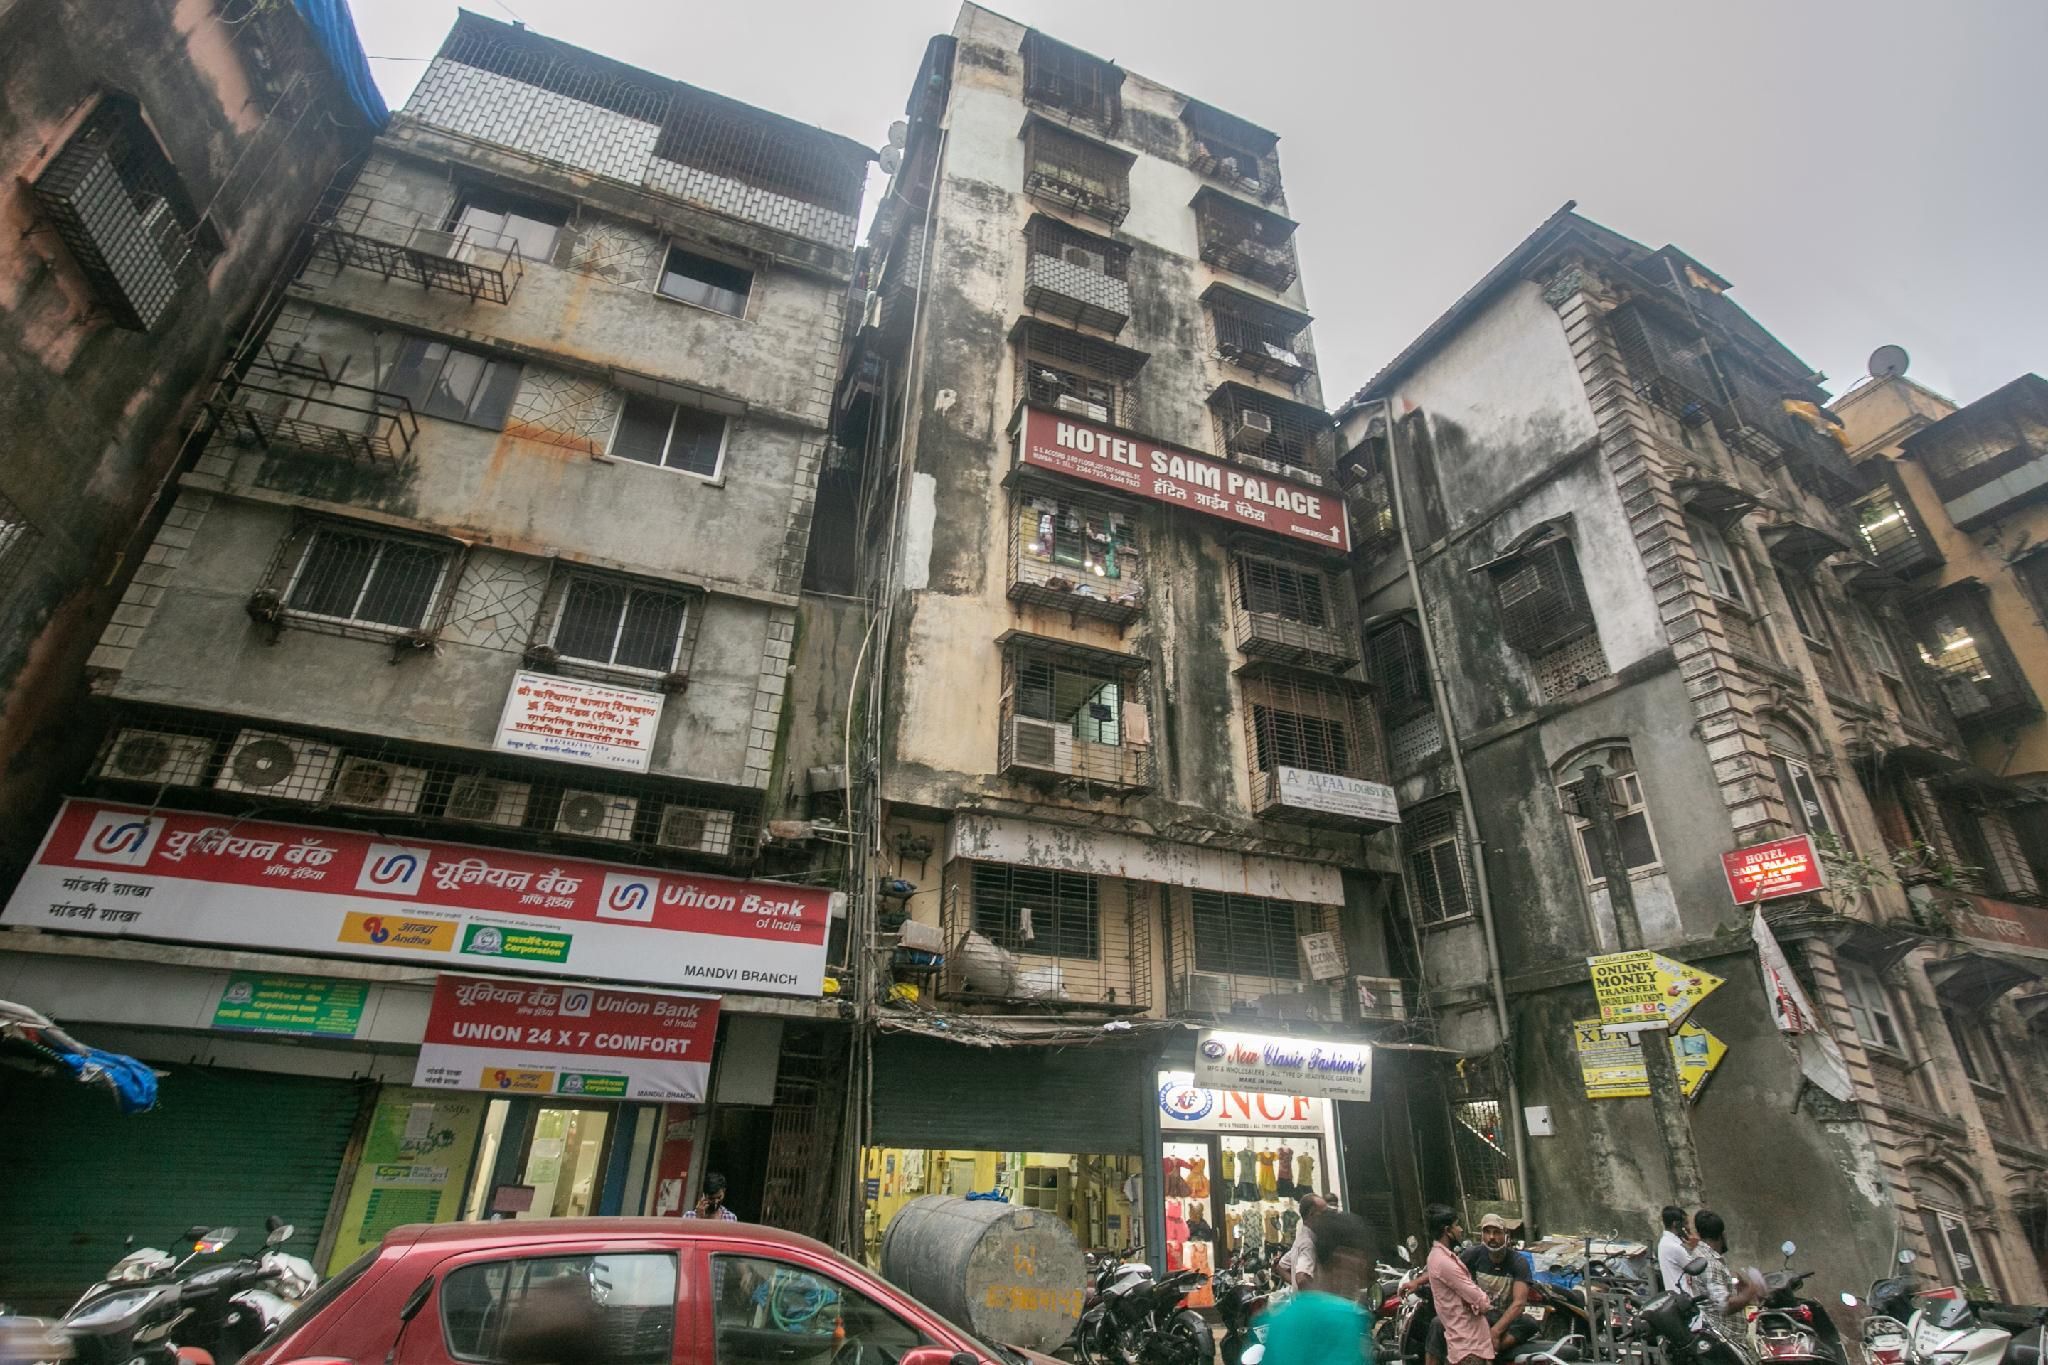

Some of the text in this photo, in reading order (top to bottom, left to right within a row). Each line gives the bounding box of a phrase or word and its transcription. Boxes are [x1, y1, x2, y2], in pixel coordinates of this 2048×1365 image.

[1057, 422, 1322, 520] HOTEL SAIM PALACE
[517, 685, 531, 697] श्री
[1745, 848, 1787, 865] HOTEL
[431, 858, 584, 895] यूनियन बैंक
[62, 875, 155, 898] मांडवी शाखा
[662, 885, 806, 917] Union Bank
[49, 900, 142, 923] मांडवी शाखा
[756, 918, 802, 932] of India
[391, 933, 432, 946] Andhra
[503, 942, 561, 958] Corporation
[684, 964, 798, 985] MANDVI BRANCH
[1597, 962, 1651, 977] ONLINE
[1596, 971, 1659, 988] MONEY
[455, 982, 525, 1007] यूनियन
[1598, 984, 1658, 997] TRANSFER
[1600, 992, 1664, 1007] ONLINE BILL PAYMENT
[596, 996, 701, 1019] Union Bank
[662, 1018, 697, 1029] of India
[452, 1021, 691, 1055] UNION 24 X 7 COMFORT
[1226, 1041, 1366, 1075] New Classic Fashion's
[637, 1090, 697, 1100] MANDVI BRANCH
[1218, 1088, 1311, 1121] NCF
